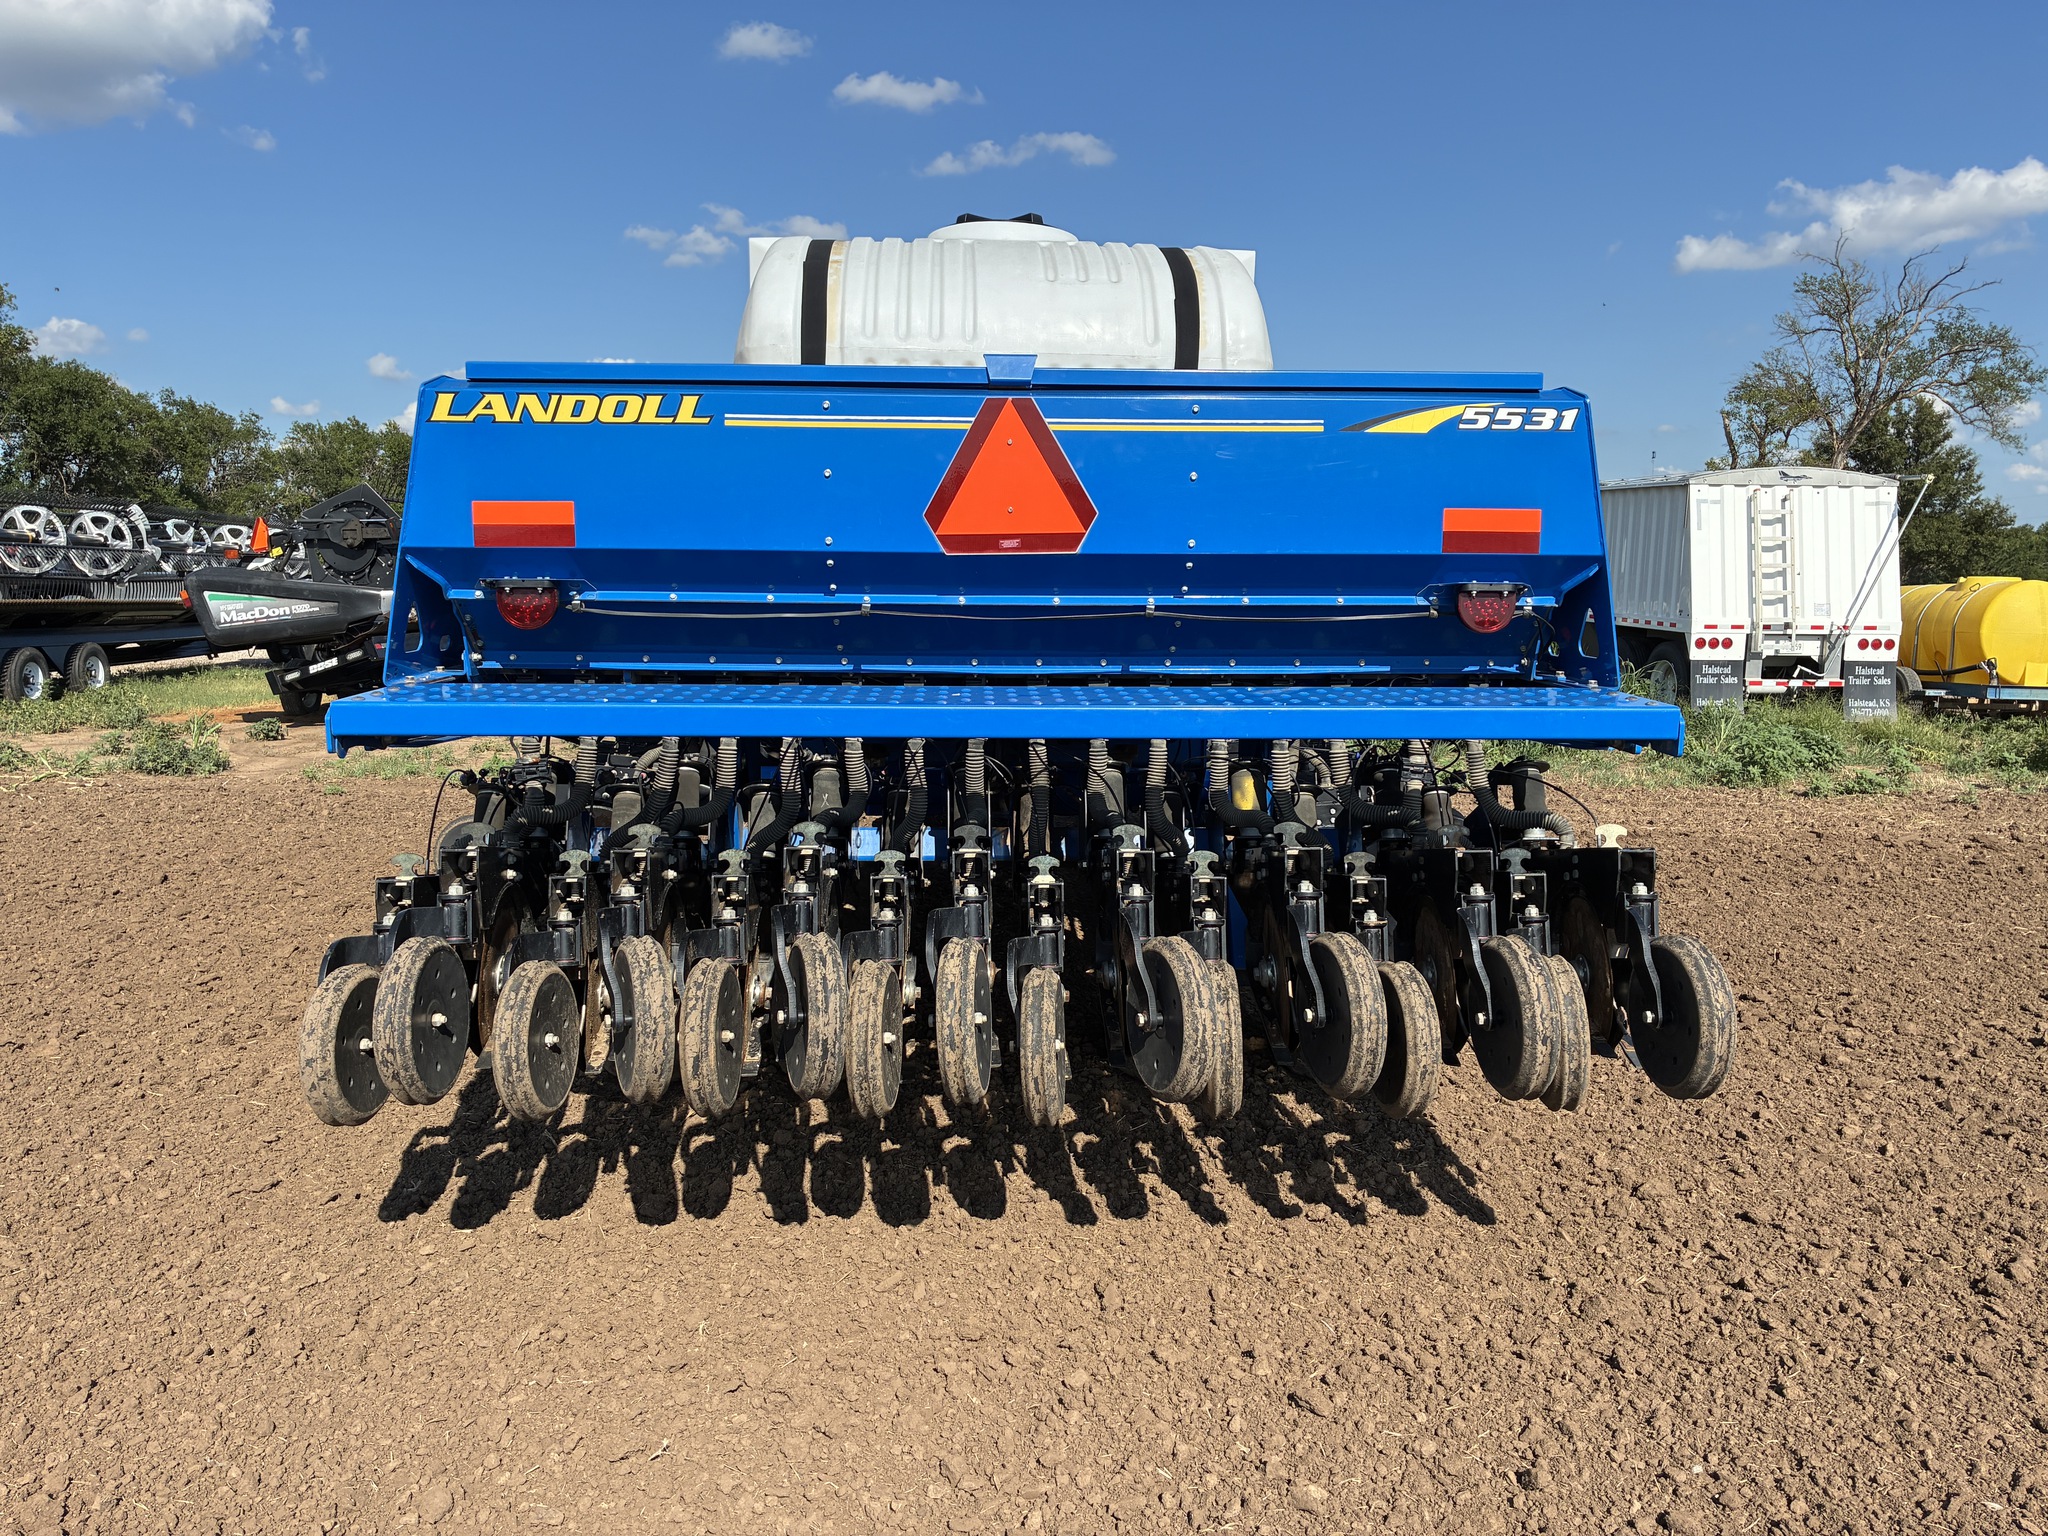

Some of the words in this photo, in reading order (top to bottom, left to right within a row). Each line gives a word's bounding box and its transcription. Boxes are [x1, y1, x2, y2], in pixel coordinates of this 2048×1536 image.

[426, 391, 714, 424] LANDOLL
[1458, 406, 1580, 432] 5531
[220, 606, 290, 624] MacDon
[1702, 664, 1732, 674] Halstead
[1855, 666, 1885, 675] Halstead
[1695, 674, 1718, 684] Trailer
[1720, 674, 1738, 685] Sales
[1848, 675, 1871, 685] Trailer
[1873, 675, 1891, 685] Sales
[1848, 698, 1878, 708] Halstead,
[1879, 698, 1890, 707] KS
